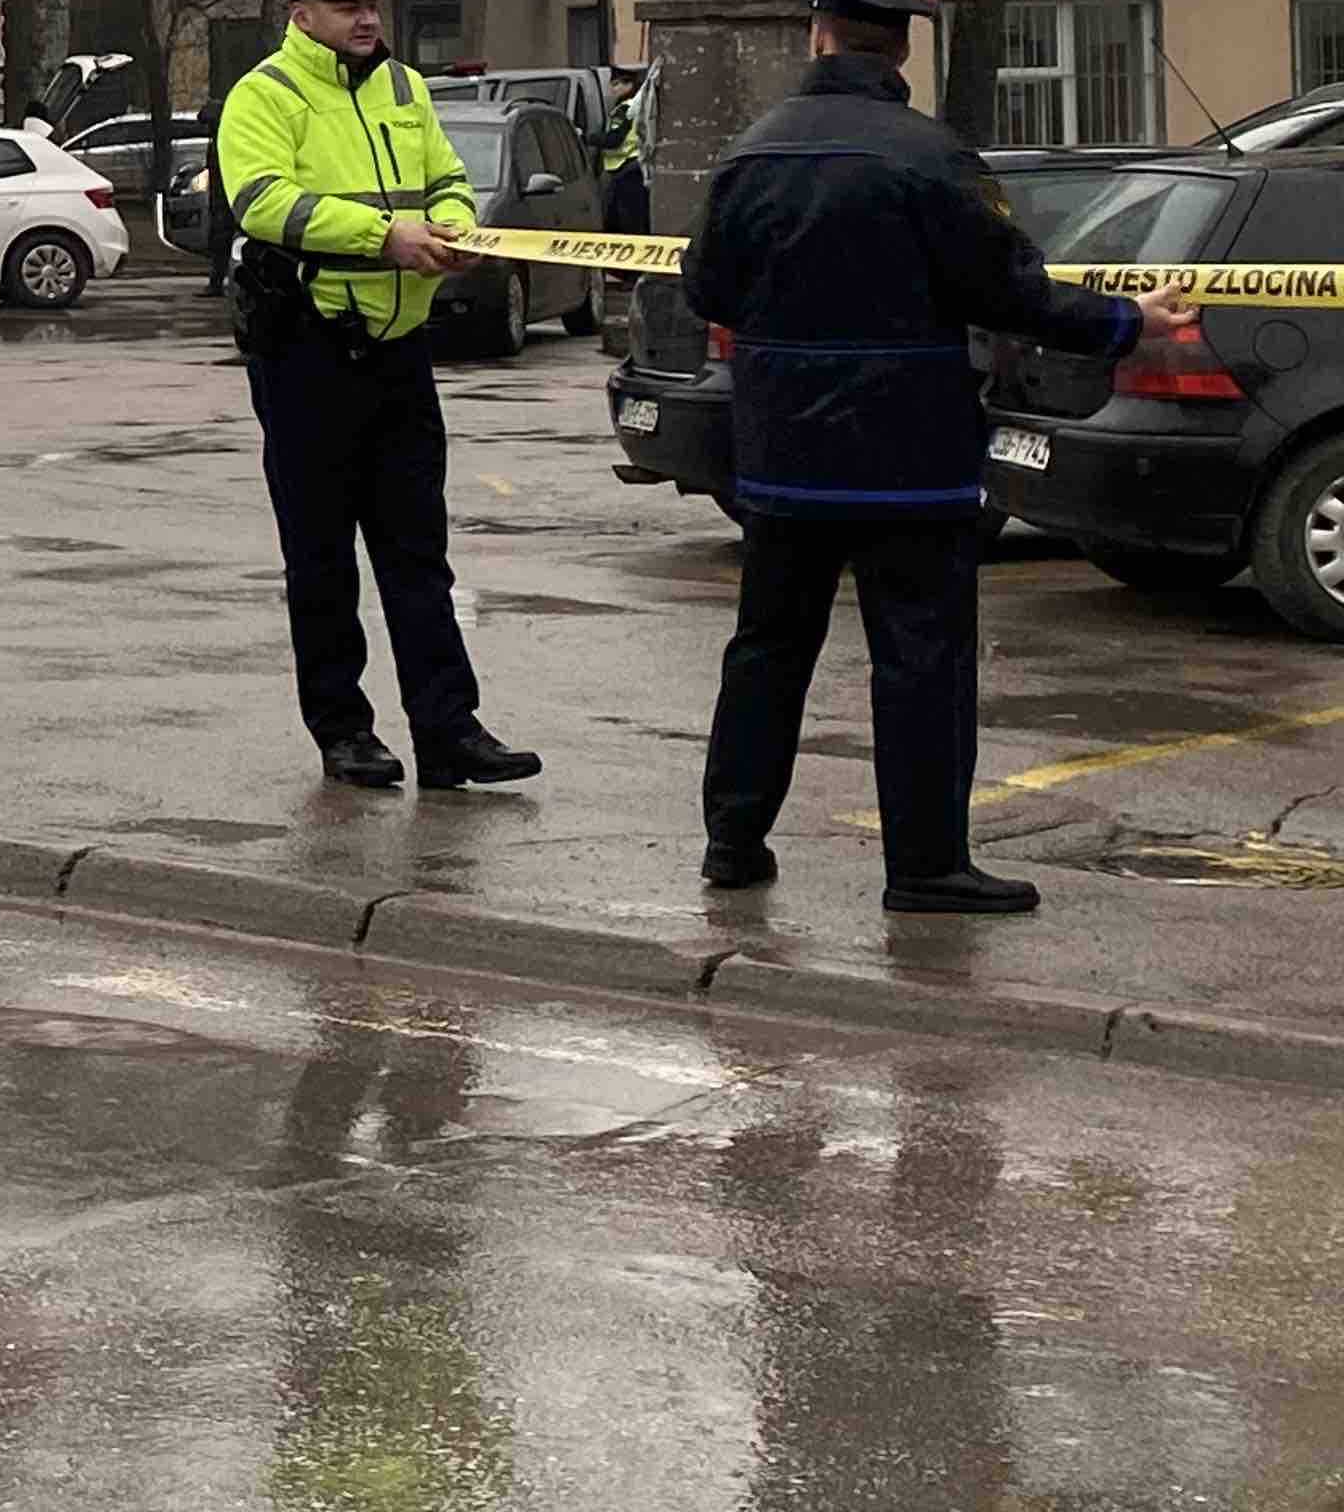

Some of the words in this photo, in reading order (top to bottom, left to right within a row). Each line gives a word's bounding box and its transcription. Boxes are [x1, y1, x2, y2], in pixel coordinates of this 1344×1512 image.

[551, 239, 636, 263] MJESTO
[1083, 268, 1198, 294] MJESTO
[1205, 269, 1338, 297] ZLOCINA
